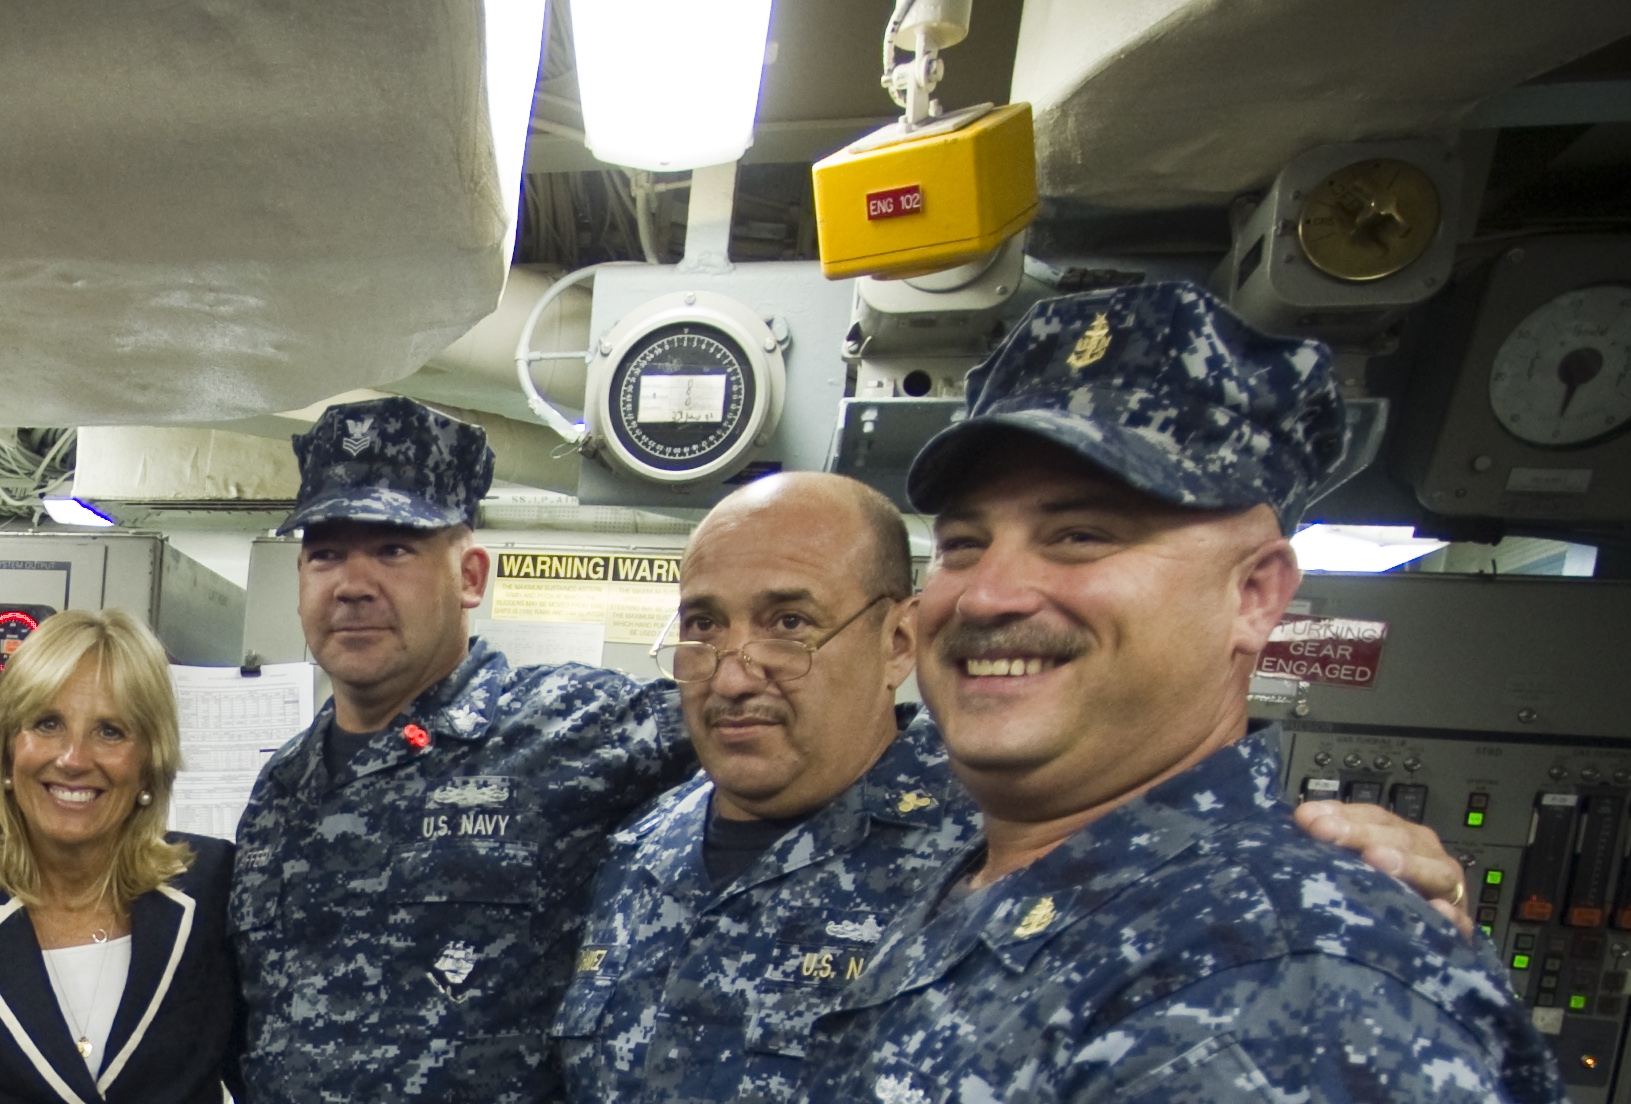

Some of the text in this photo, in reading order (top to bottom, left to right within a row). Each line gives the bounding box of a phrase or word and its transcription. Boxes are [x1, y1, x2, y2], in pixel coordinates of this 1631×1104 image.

[869, 192, 921, 216] ENG 102
[24, 561, 56, 570] OUTPUT
[502, 555, 605, 580] WARNING
[1279, 619, 1377, 643] TURNING
[1289, 641, 1353, 661] GEAR
[1261, 657, 1372, 682] ENGAGED
[422, 814, 510, 838] U.S. NAVY
[801, 952, 864, 981] U.S. N
